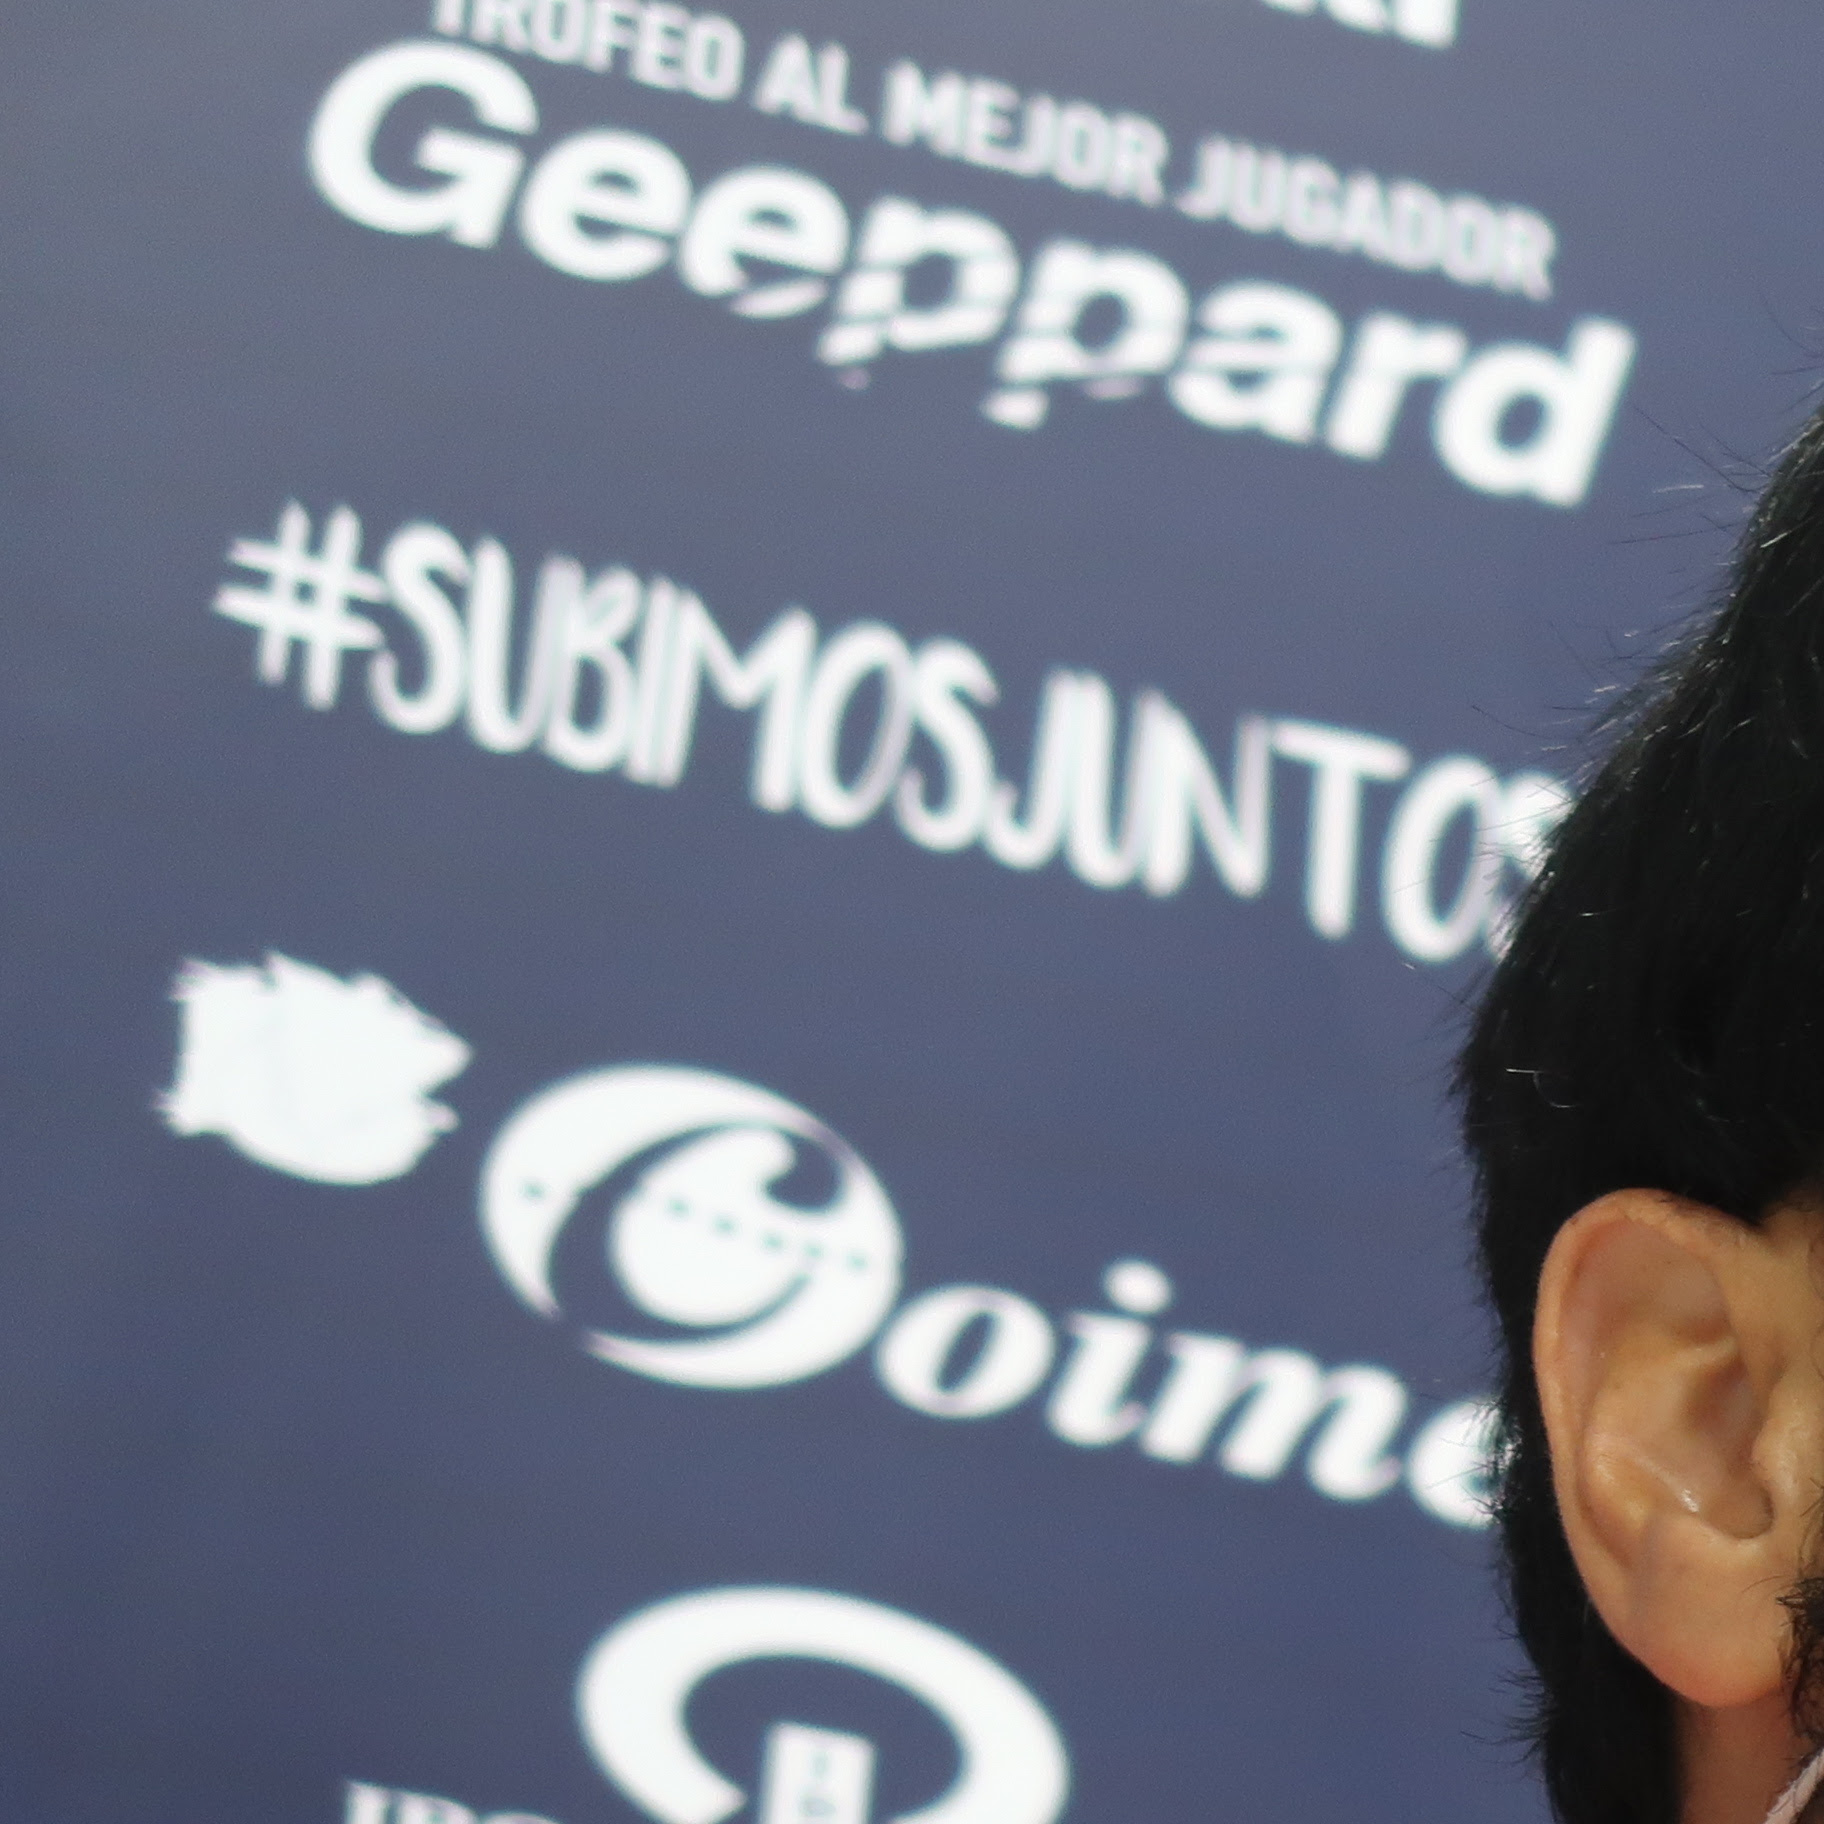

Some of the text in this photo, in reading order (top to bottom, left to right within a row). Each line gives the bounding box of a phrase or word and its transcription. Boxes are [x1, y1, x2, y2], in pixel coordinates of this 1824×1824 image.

[308, 38, 1636, 504] Geeppard
[754, 30, 868, 136] AL
[880, 56, 1168, 206] MEJOR
[1176, 132, 1558, 302] JUGADOR
